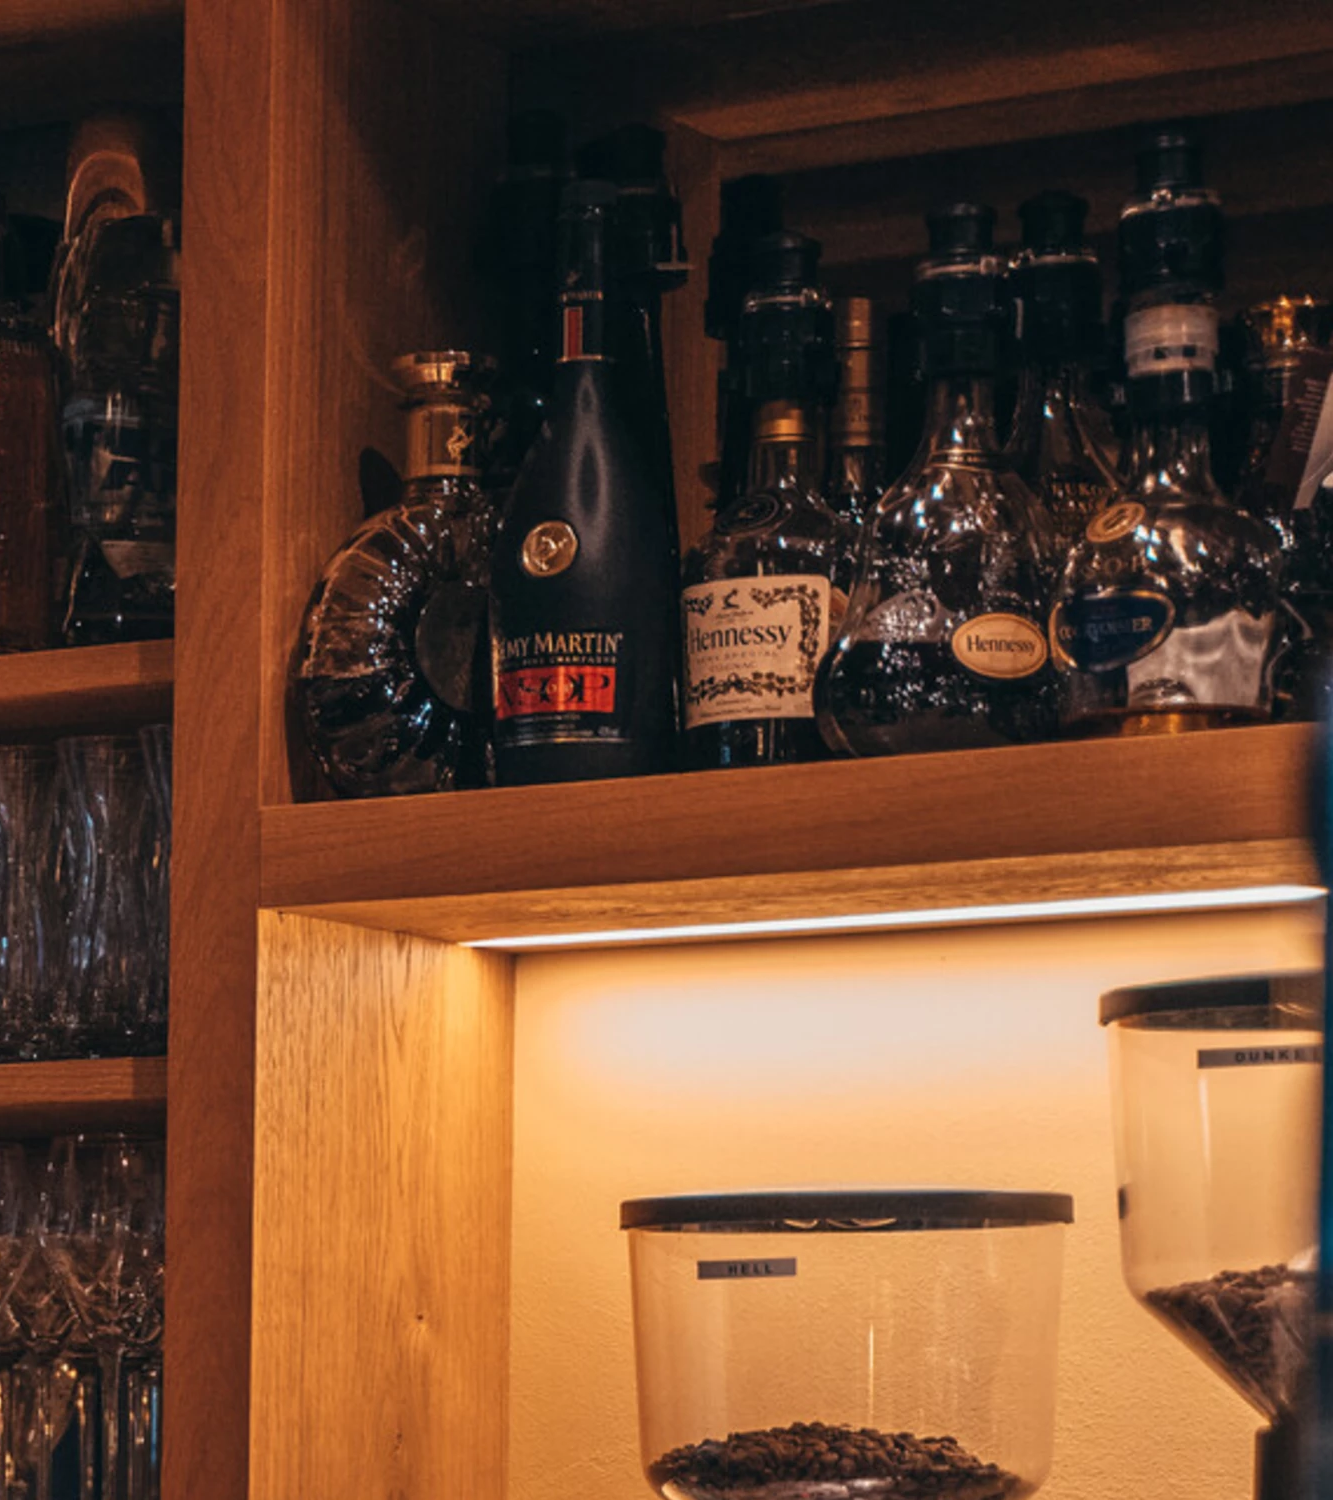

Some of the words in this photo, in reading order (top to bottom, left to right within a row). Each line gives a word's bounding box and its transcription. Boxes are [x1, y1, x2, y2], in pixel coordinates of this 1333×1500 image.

[534, 631, 617, 655] MARTIN
[689, 625, 793, 654] Hennessy
[966, 637, 1035, 657] Hennessy
[727, 1263, 774, 1277] HELL
